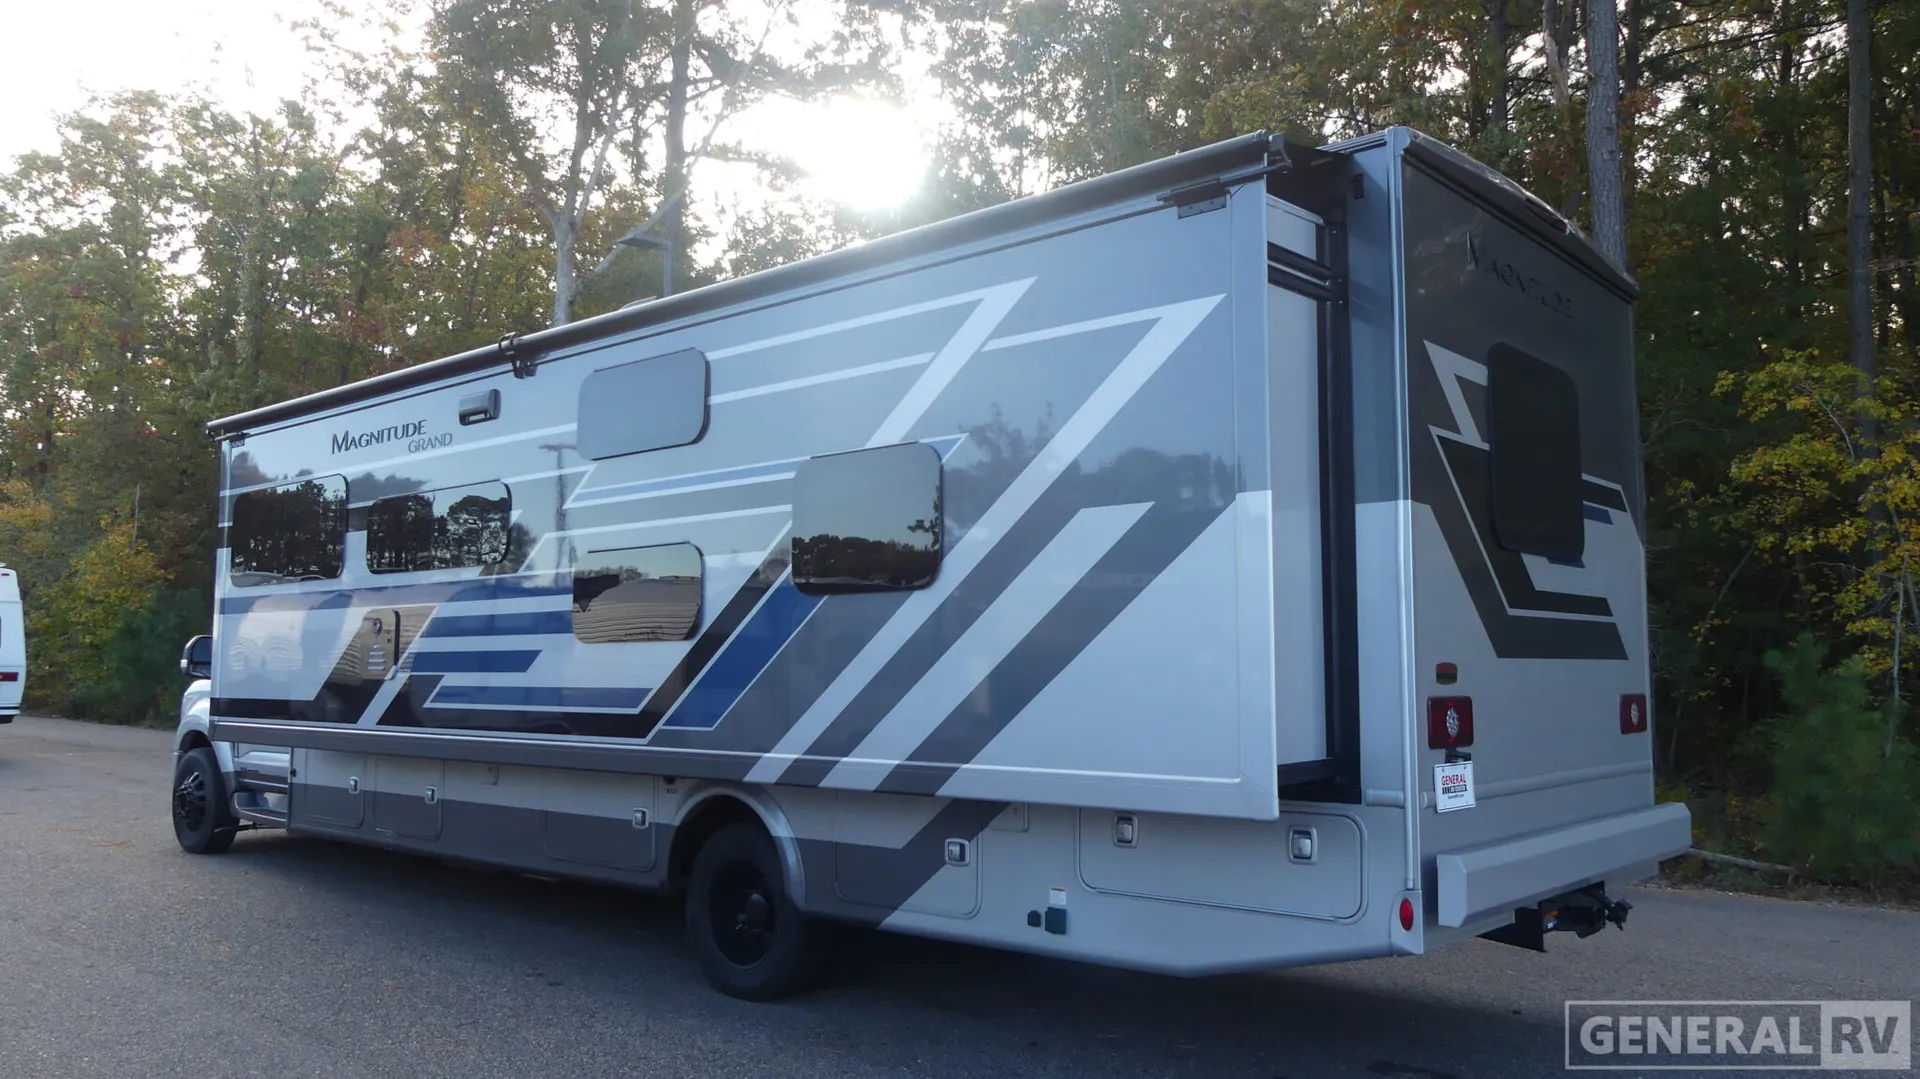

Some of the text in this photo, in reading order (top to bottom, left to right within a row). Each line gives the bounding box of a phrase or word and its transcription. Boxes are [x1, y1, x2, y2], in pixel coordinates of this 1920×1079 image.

[332, 419, 428, 455] MAGNITUDE
[408, 432, 453, 454] GRAND
[1441, 773, 1467, 786] GENERAL
